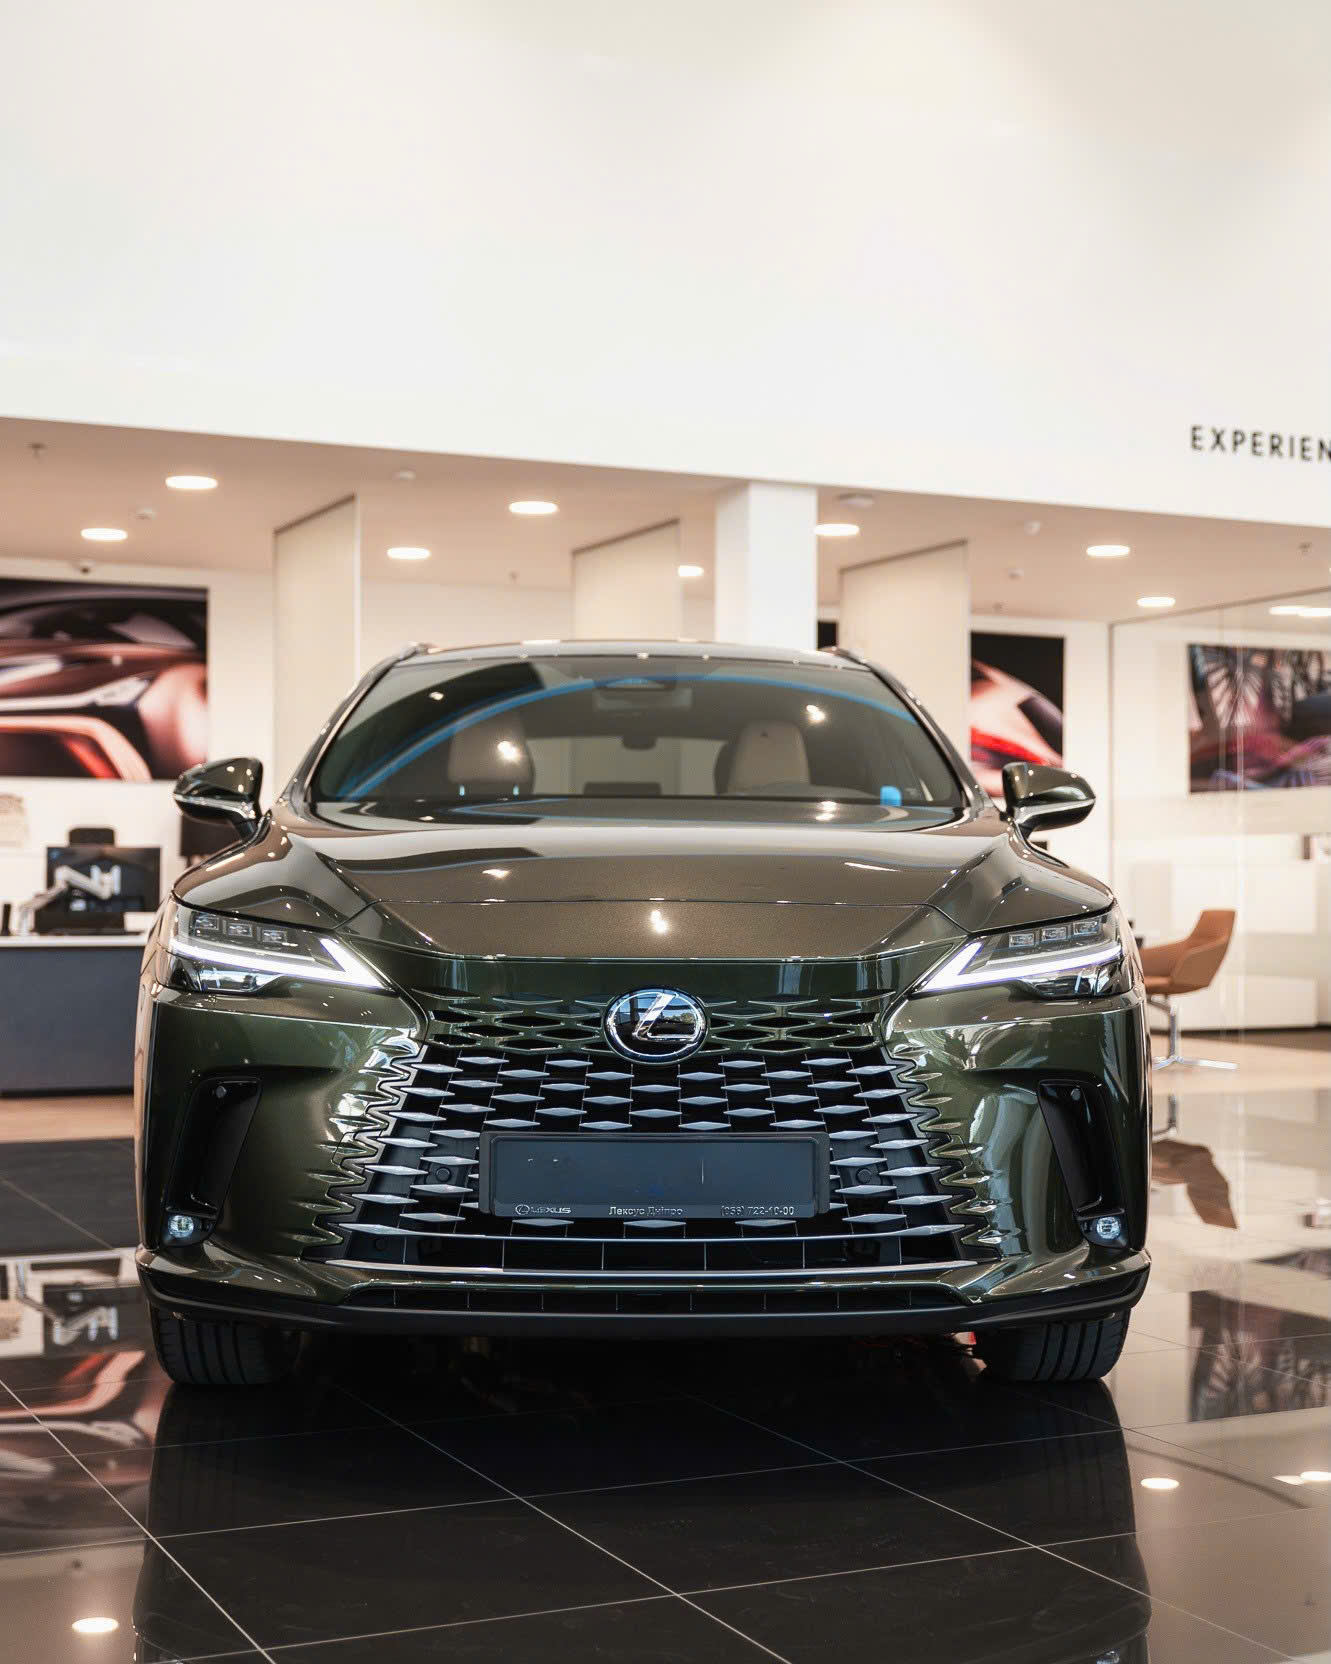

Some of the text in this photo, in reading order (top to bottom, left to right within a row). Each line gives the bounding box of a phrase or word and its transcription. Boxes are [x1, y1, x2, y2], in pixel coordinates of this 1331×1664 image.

[1190, 425, 1331, 461] EXPERIEN
[530, 1206, 572, 1214] LEXUS
[608, 1206, 645, 1217] Лексус
